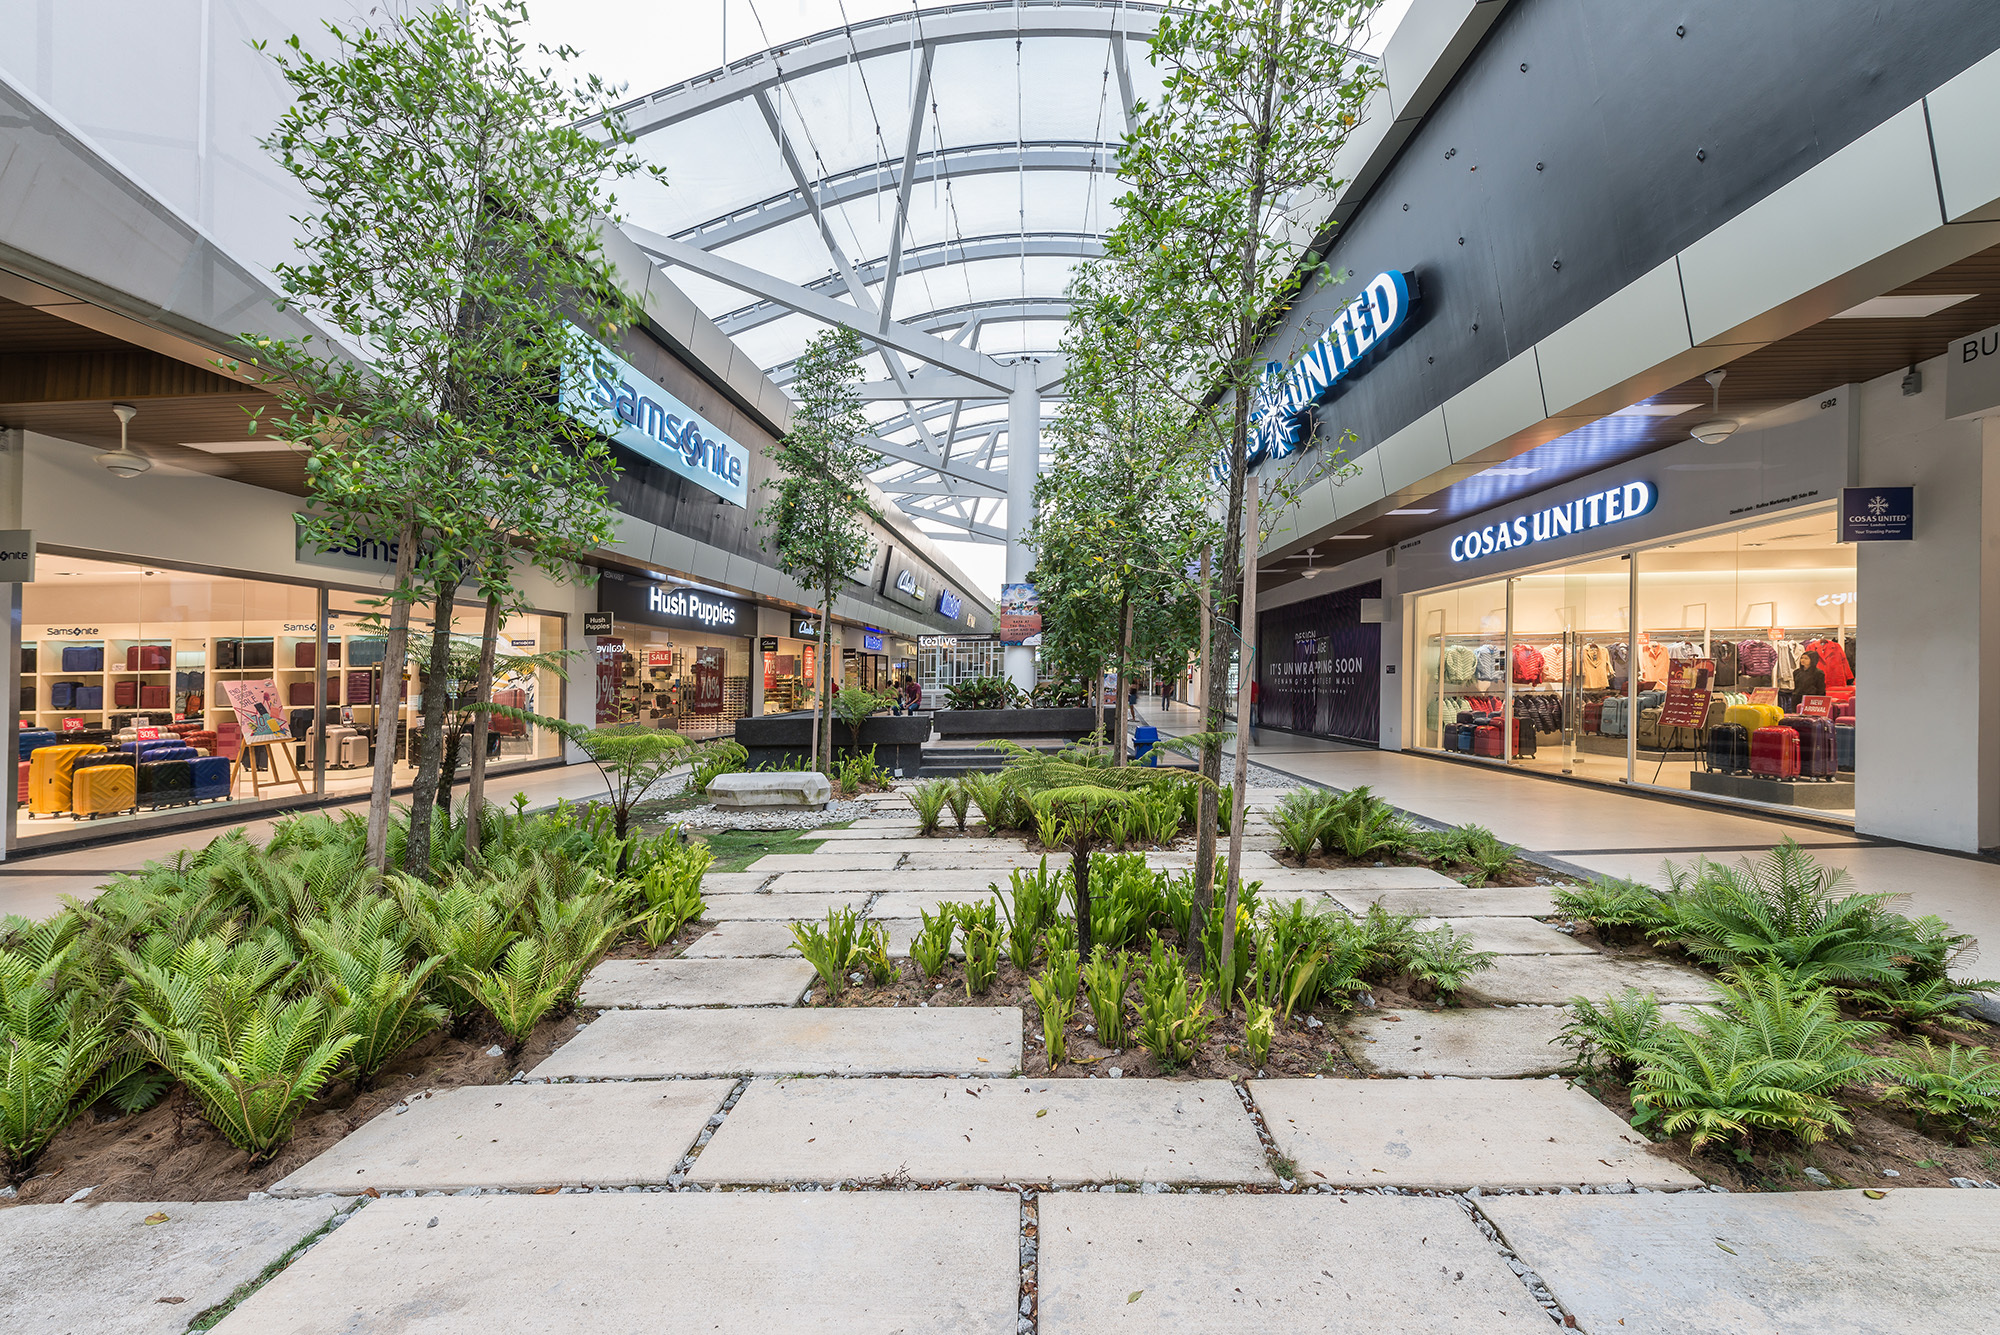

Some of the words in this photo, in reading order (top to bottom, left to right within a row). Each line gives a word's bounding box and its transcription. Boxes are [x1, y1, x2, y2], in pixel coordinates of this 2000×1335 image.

[1284, 272, 1402, 411] UNITED
[1963, 332, 1999, 363] BU
[1820, 398, 1837, 409] G92
[591, 357, 742, 487] Samsonite
[1769, 496, 1790, 507] Marketing
[1450, 516, 1528, 562] COSAS
[1532, 481, 1650, 542] UNITED
[1848, 515, 1877, 523] COSAS
[1878, 514, 1907, 522] UNITED
[650, 586, 687, 616] Hush
[689, 595, 736, 626] Puppies
[47, 627, 98, 636] Samsonite
[283, 623, 335, 631] Samsoe
[919, 635, 957, 647] tealive
[1270, 663, 1281, 675] IT'S
[1283, 659, 1333, 675] UNWRAPPING
[1335, 657, 1363, 673] SOON
[1803, 705, 1827, 713] ARRIVAL
[65, 719, 81, 728] 30%
[138, 730, 156, 739] 30%
